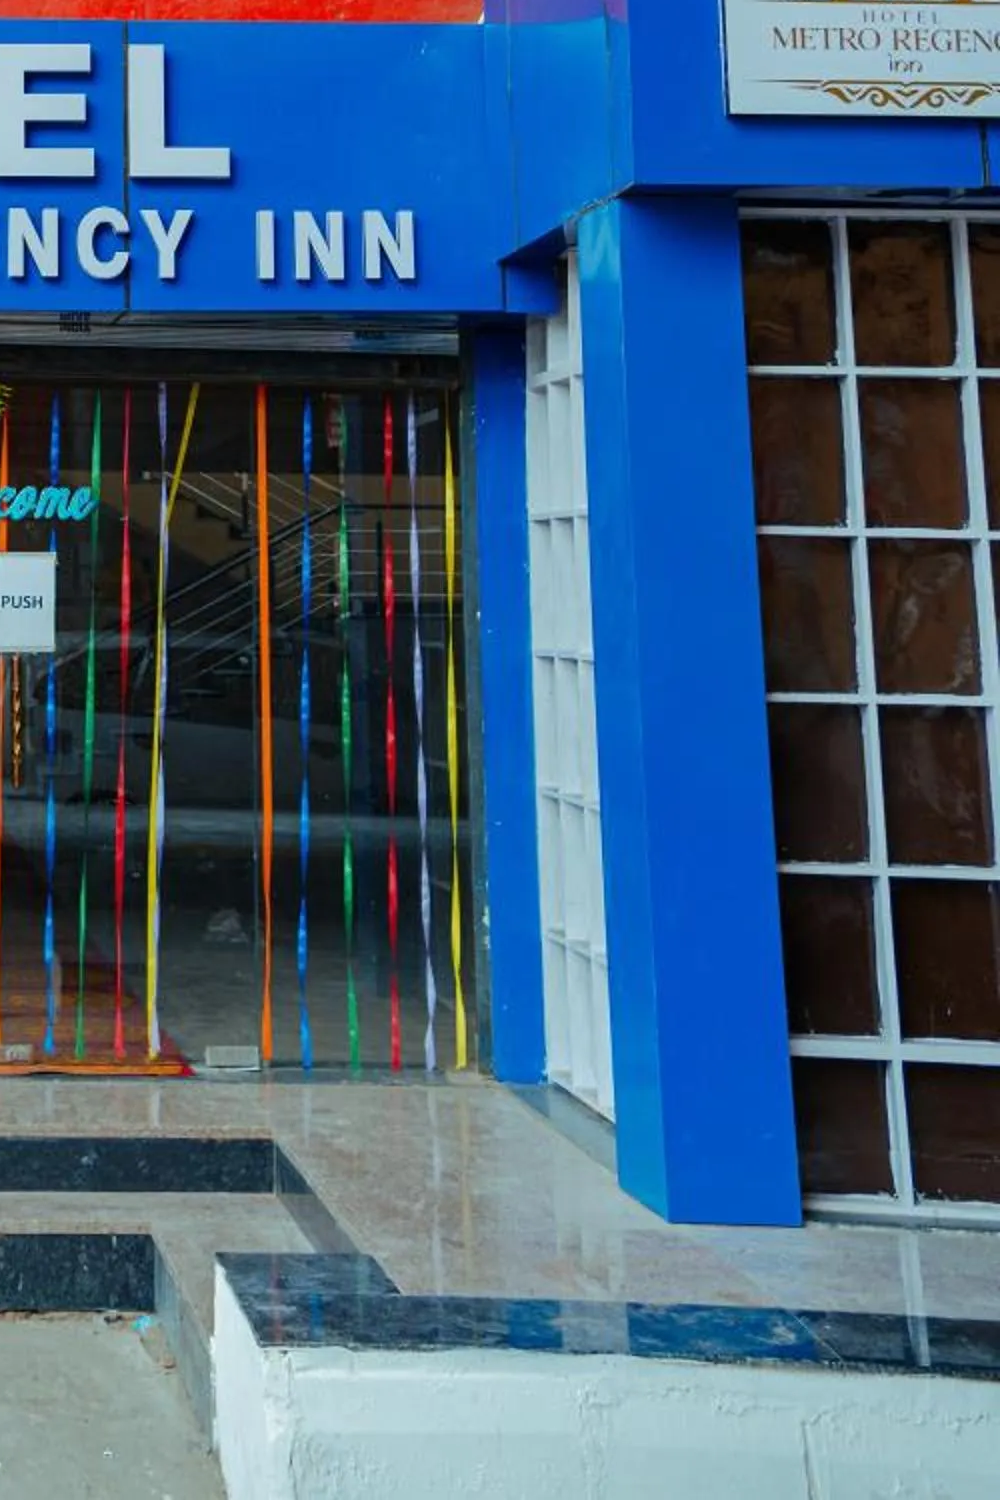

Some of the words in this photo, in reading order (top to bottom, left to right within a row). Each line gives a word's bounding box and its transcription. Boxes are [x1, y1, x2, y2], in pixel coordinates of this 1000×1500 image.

[862, 9, 940, 25] HOTEL
[772, 26, 881, 50] METRO
[254, 209, 417, 280] INN
[1, 595, 43, 608] PUSH
